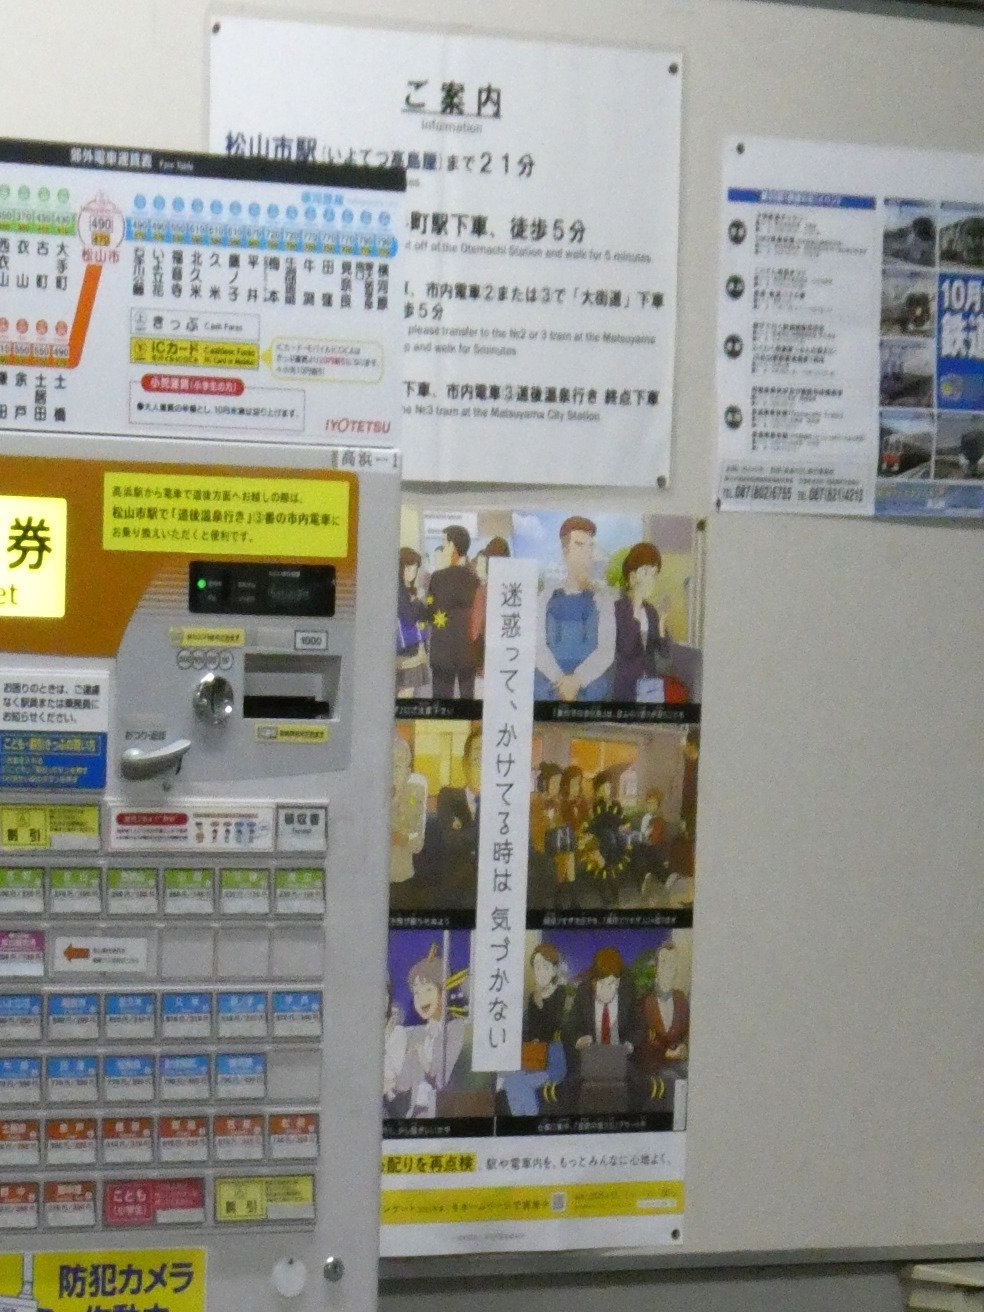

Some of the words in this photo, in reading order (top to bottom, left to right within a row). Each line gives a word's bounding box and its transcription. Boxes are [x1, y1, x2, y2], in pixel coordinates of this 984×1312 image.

[404, 79, 501, 119] ご案内
[91, 218, 111, 230] 490
[407, 211, 587, 244] 町駅下車、徒歩5分
[153, 315, 198, 332] きっぷ
[325, 417, 391, 434] IYOTETSU
[488, 905, 512, 1049] 気づかない
[380, 1153, 475, 1176] 配りを再点検
[59, 1262, 195, 1299] 防犯カメラ
